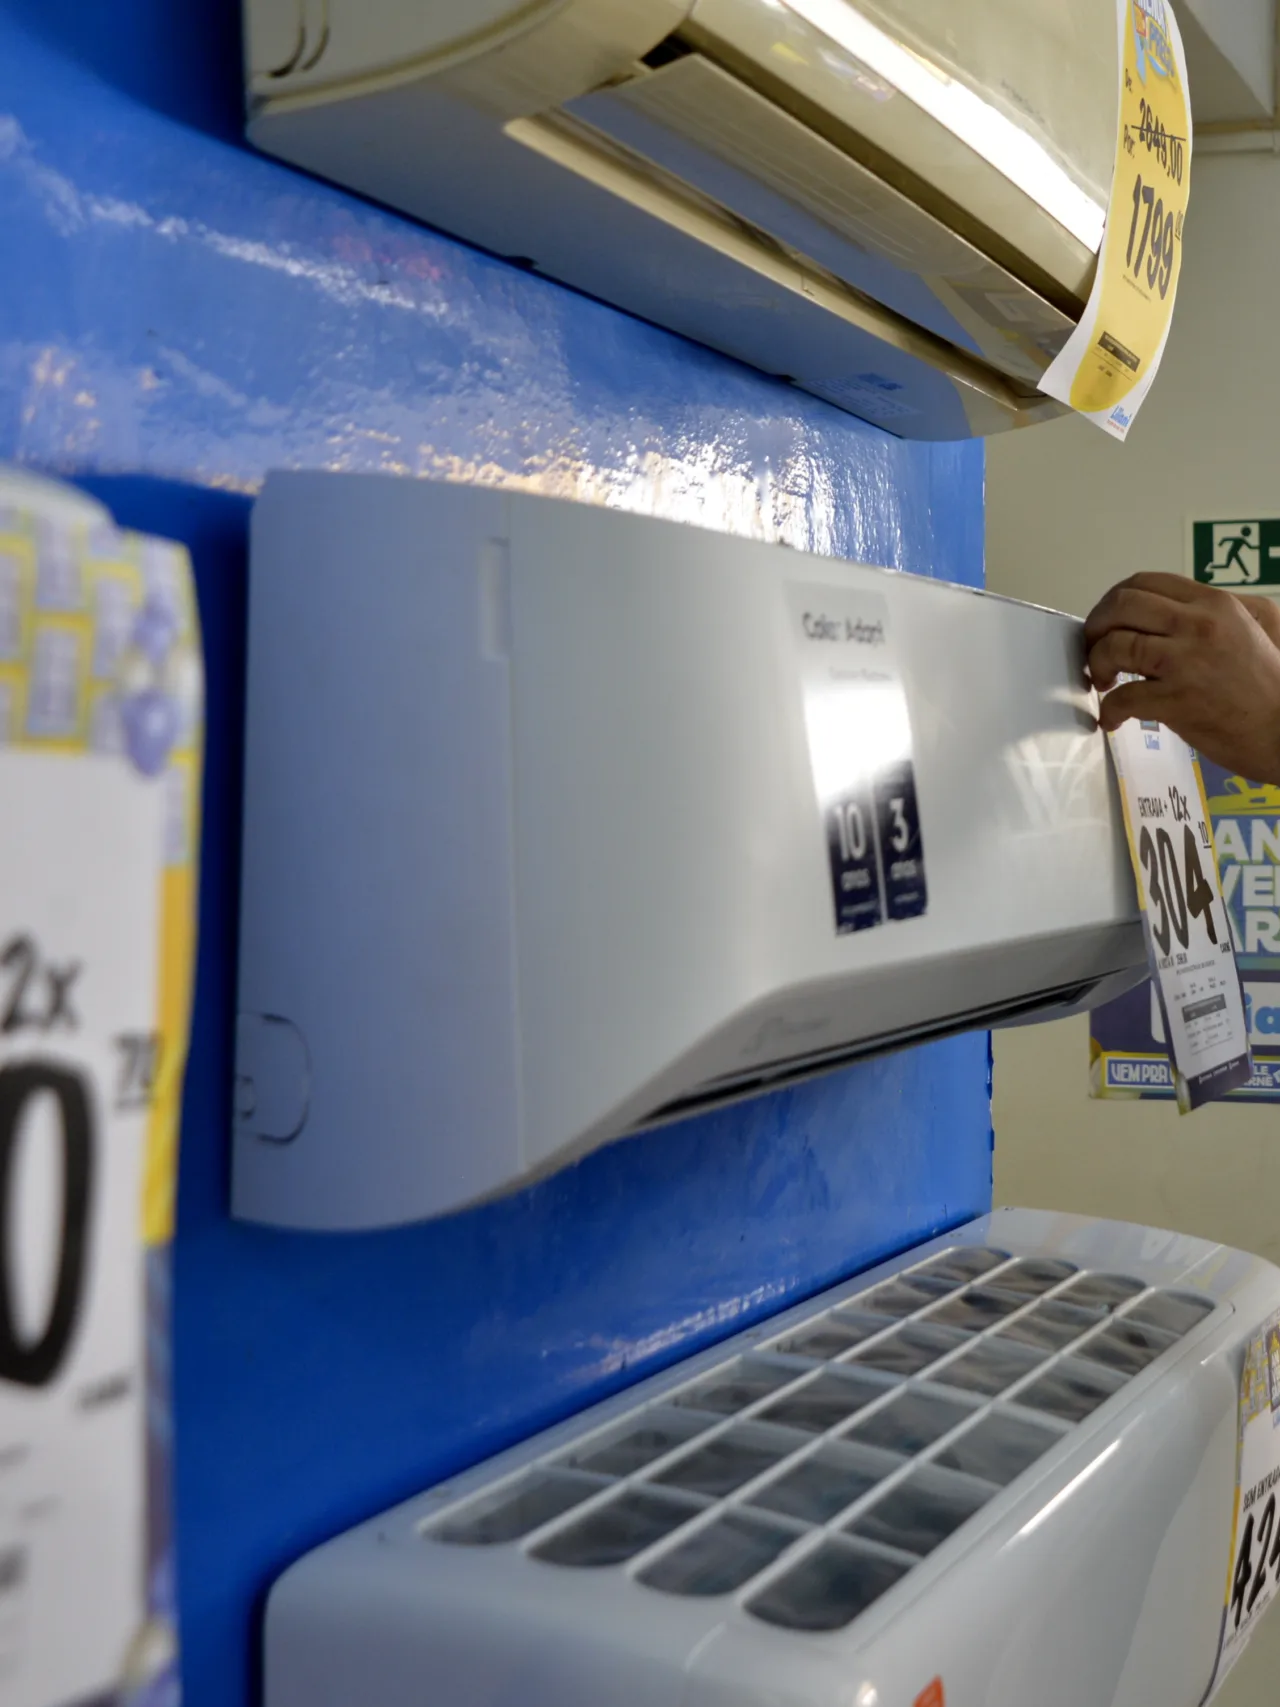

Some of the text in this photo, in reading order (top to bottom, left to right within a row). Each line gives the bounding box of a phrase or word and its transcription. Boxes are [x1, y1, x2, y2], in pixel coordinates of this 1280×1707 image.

[1126, 173, 1174, 300] 1799
[834, 802, 866, 863] 10
[888, 798, 910, 853] 3
[1139, 824, 1218, 957] 304
